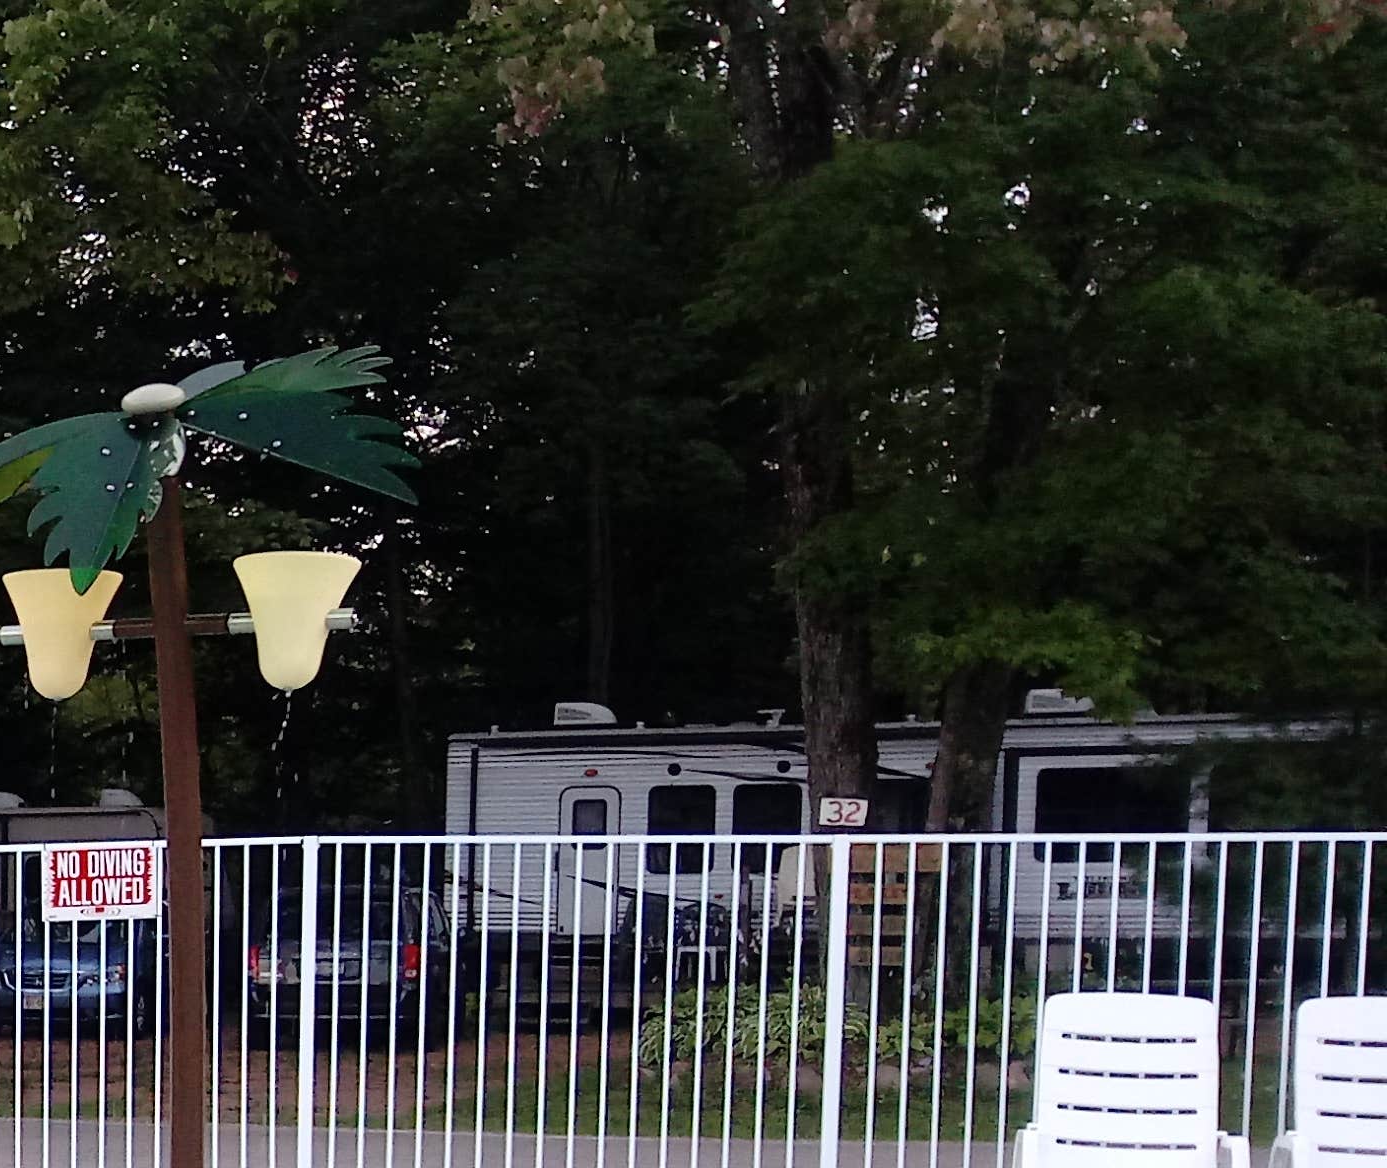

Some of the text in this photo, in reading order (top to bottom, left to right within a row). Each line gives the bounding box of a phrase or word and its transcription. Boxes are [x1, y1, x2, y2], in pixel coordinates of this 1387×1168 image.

[827, 800, 861, 823] 32
[56, 849, 146, 878] NO DIVING
[58, 876, 145, 907] ALLOWED
